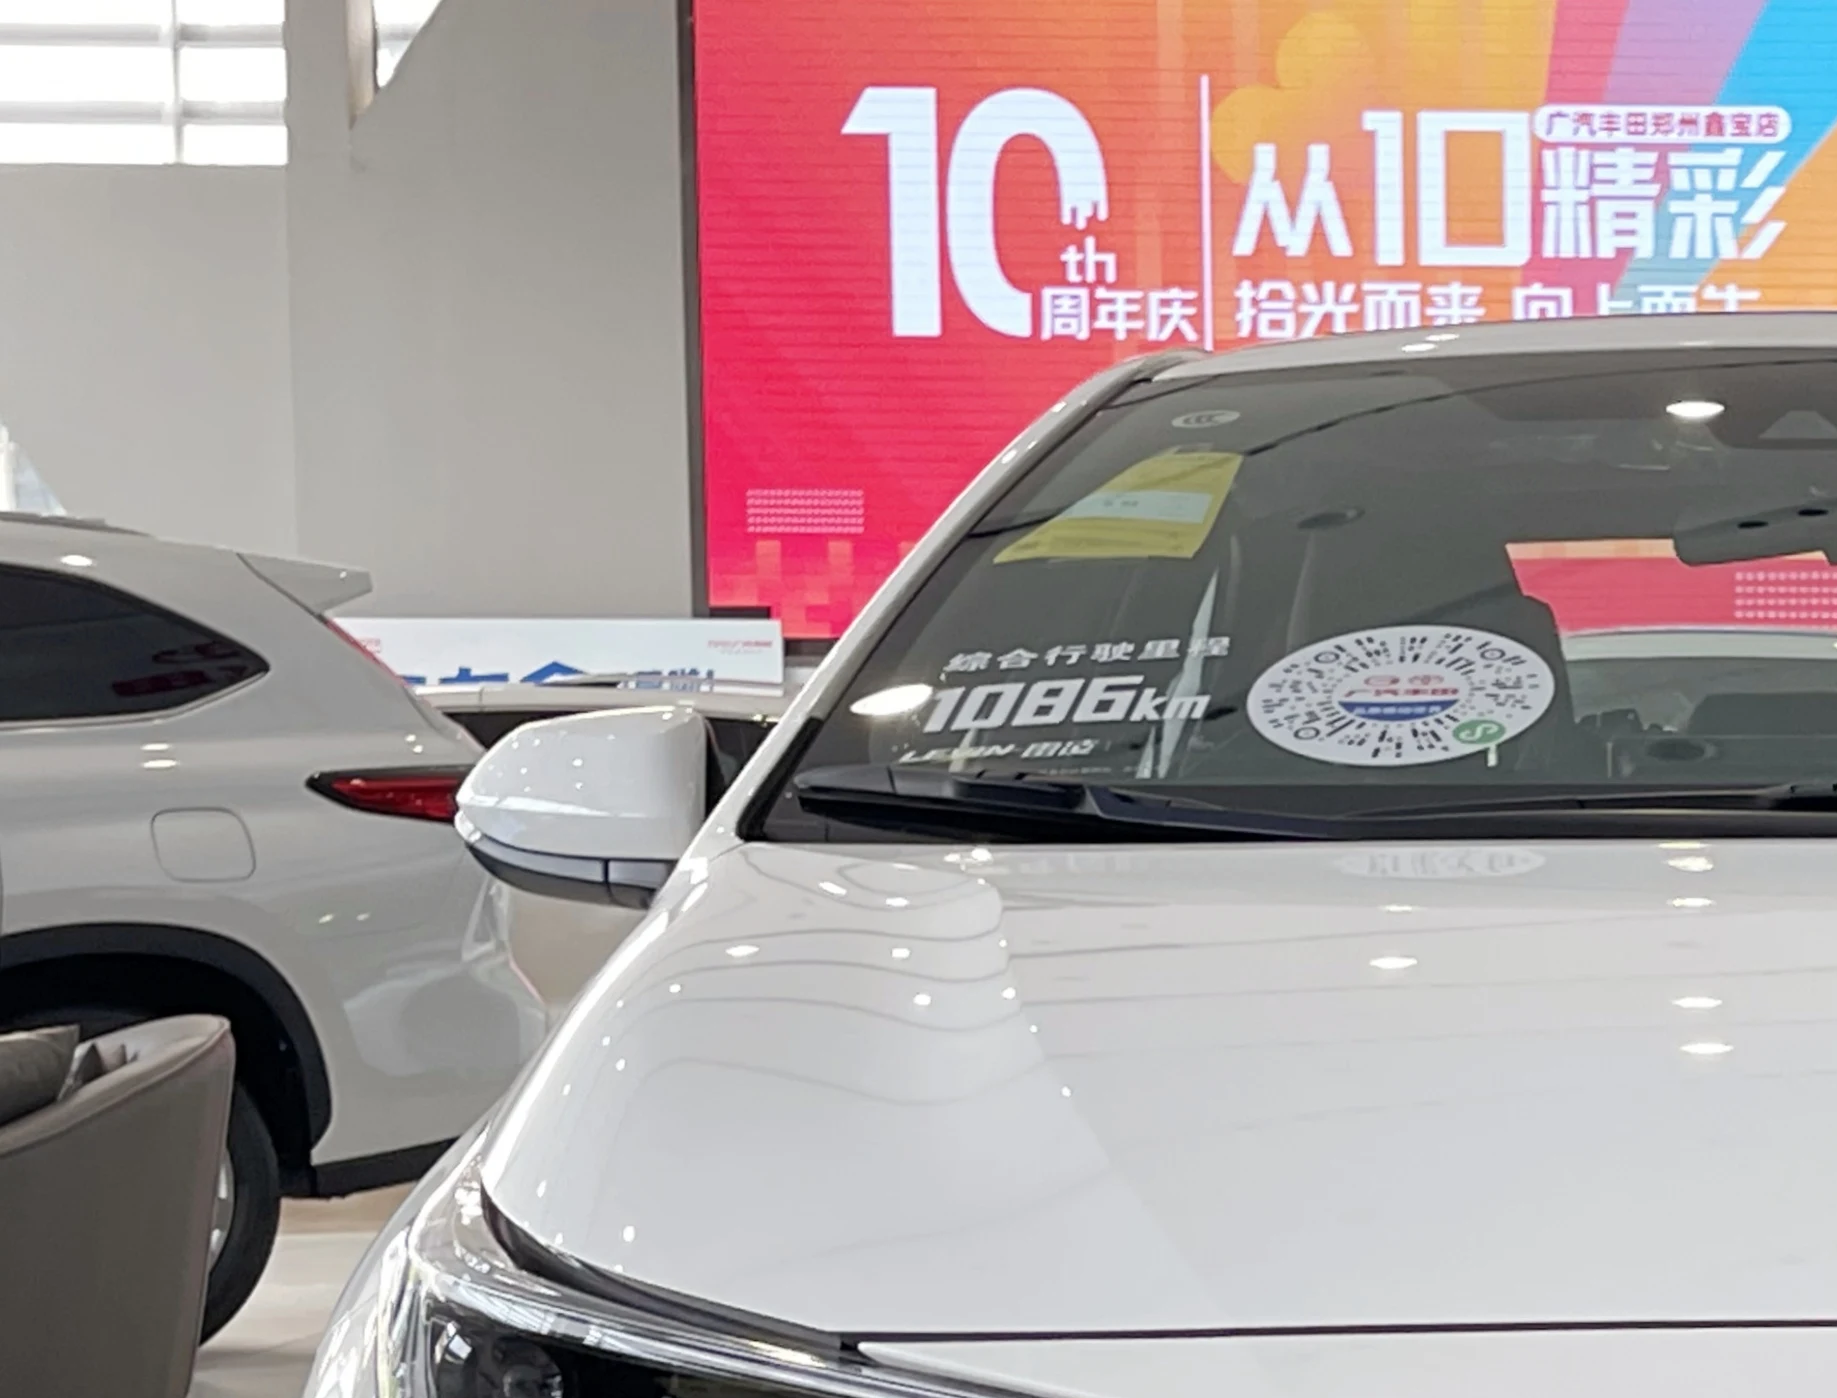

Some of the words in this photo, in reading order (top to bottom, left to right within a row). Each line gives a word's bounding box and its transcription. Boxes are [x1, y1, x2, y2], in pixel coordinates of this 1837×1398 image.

[1545, 110, 1781, 138] 广汽丰田郑州鑫宝店
[1040, 286, 1199, 341] 周年庆
[1233, 279, 1486, 340] 拾光而来
